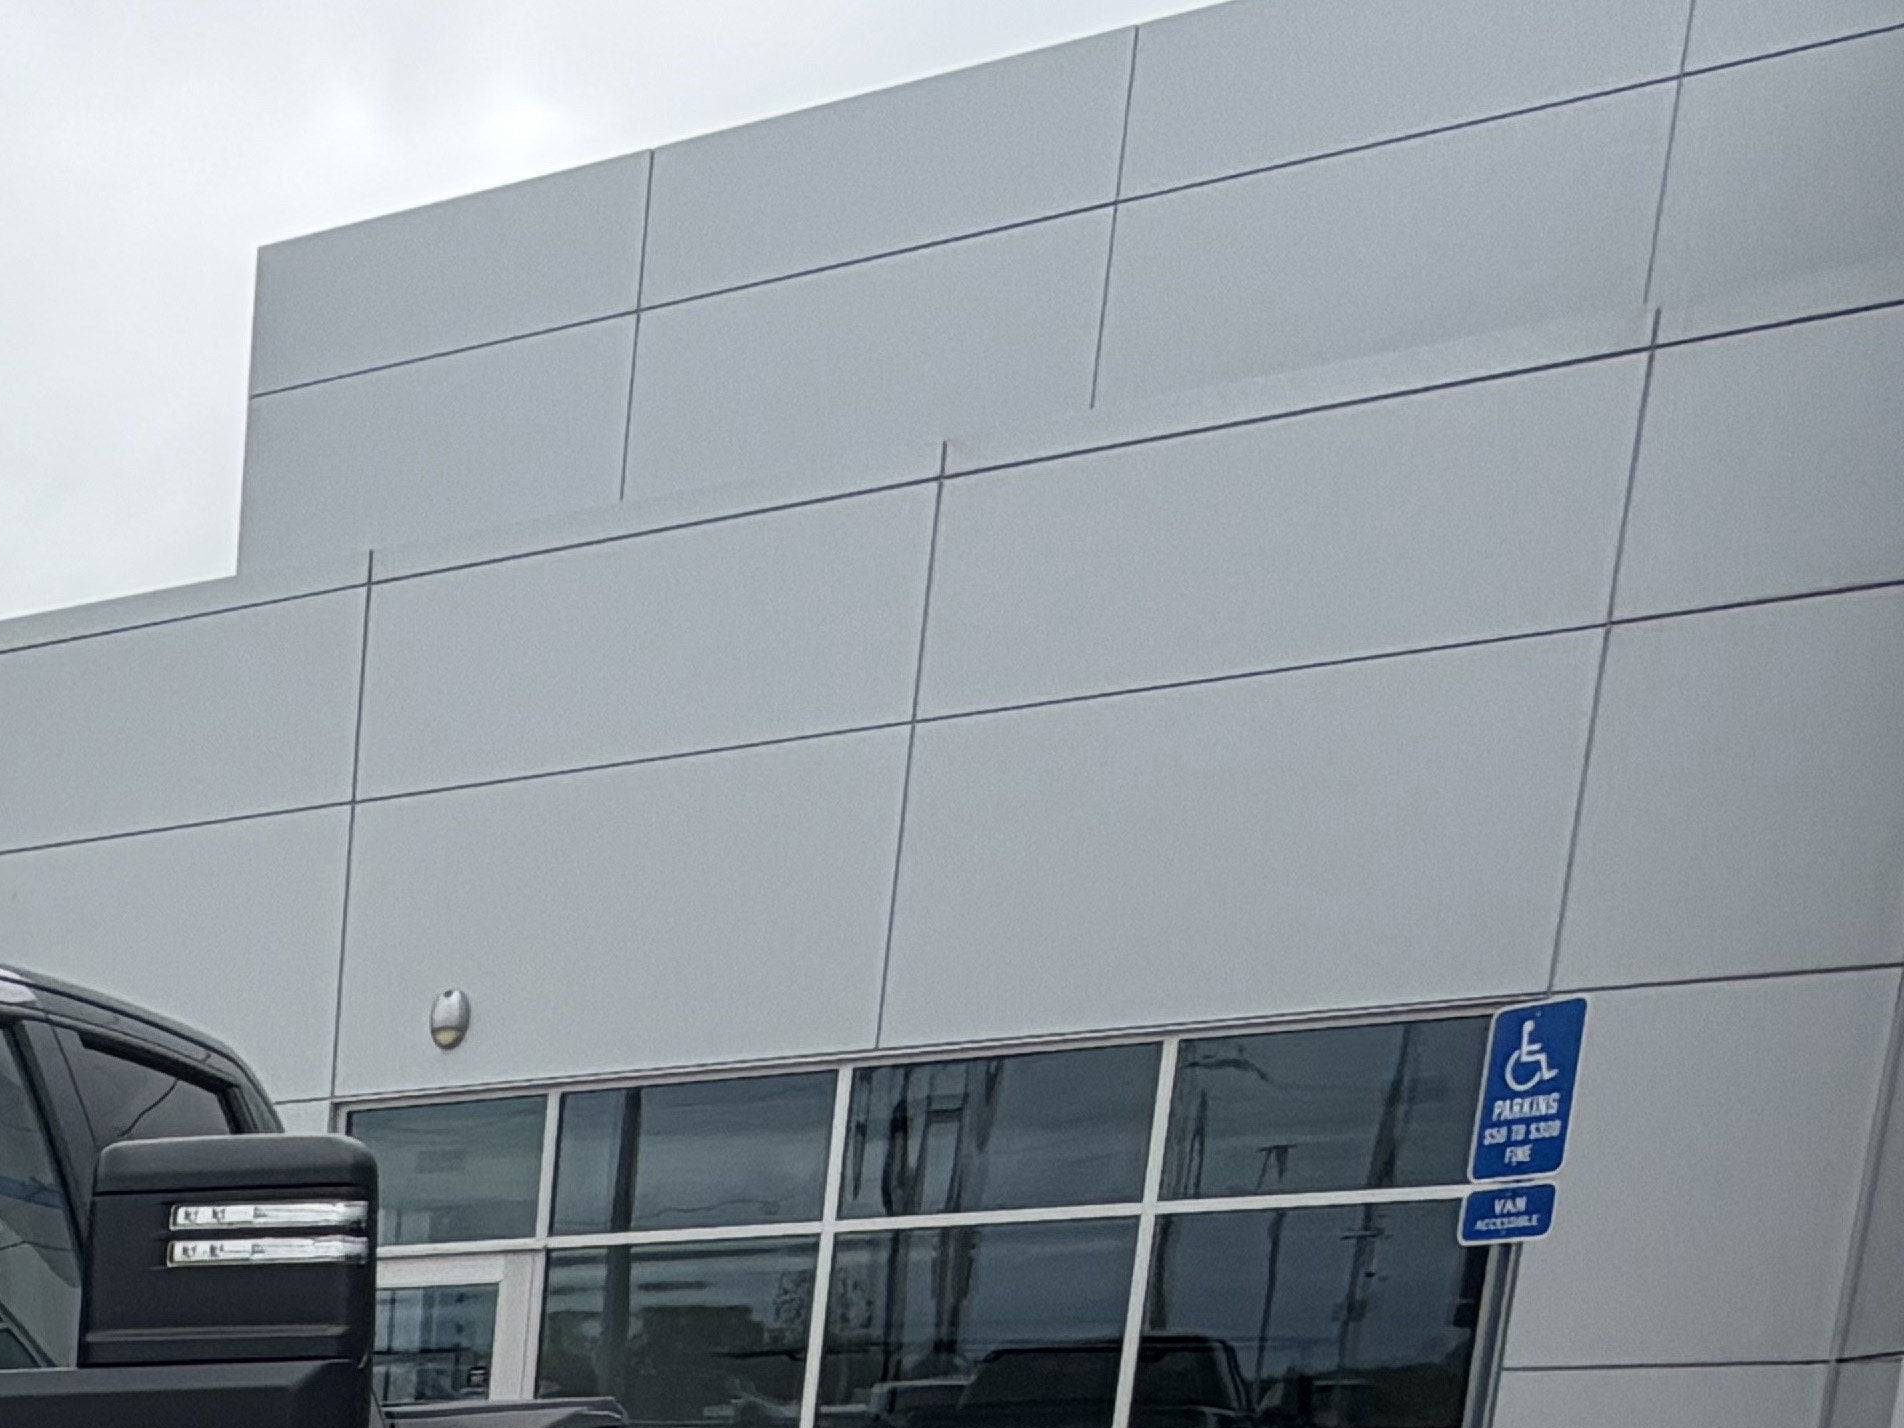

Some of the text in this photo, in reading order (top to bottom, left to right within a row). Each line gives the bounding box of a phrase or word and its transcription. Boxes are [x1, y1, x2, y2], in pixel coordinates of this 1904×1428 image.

[1492, 1093, 1561, 1122] PARKING
[1504, 1145, 1533, 1165] FINE
[1494, 1197, 1528, 1215] VAN
